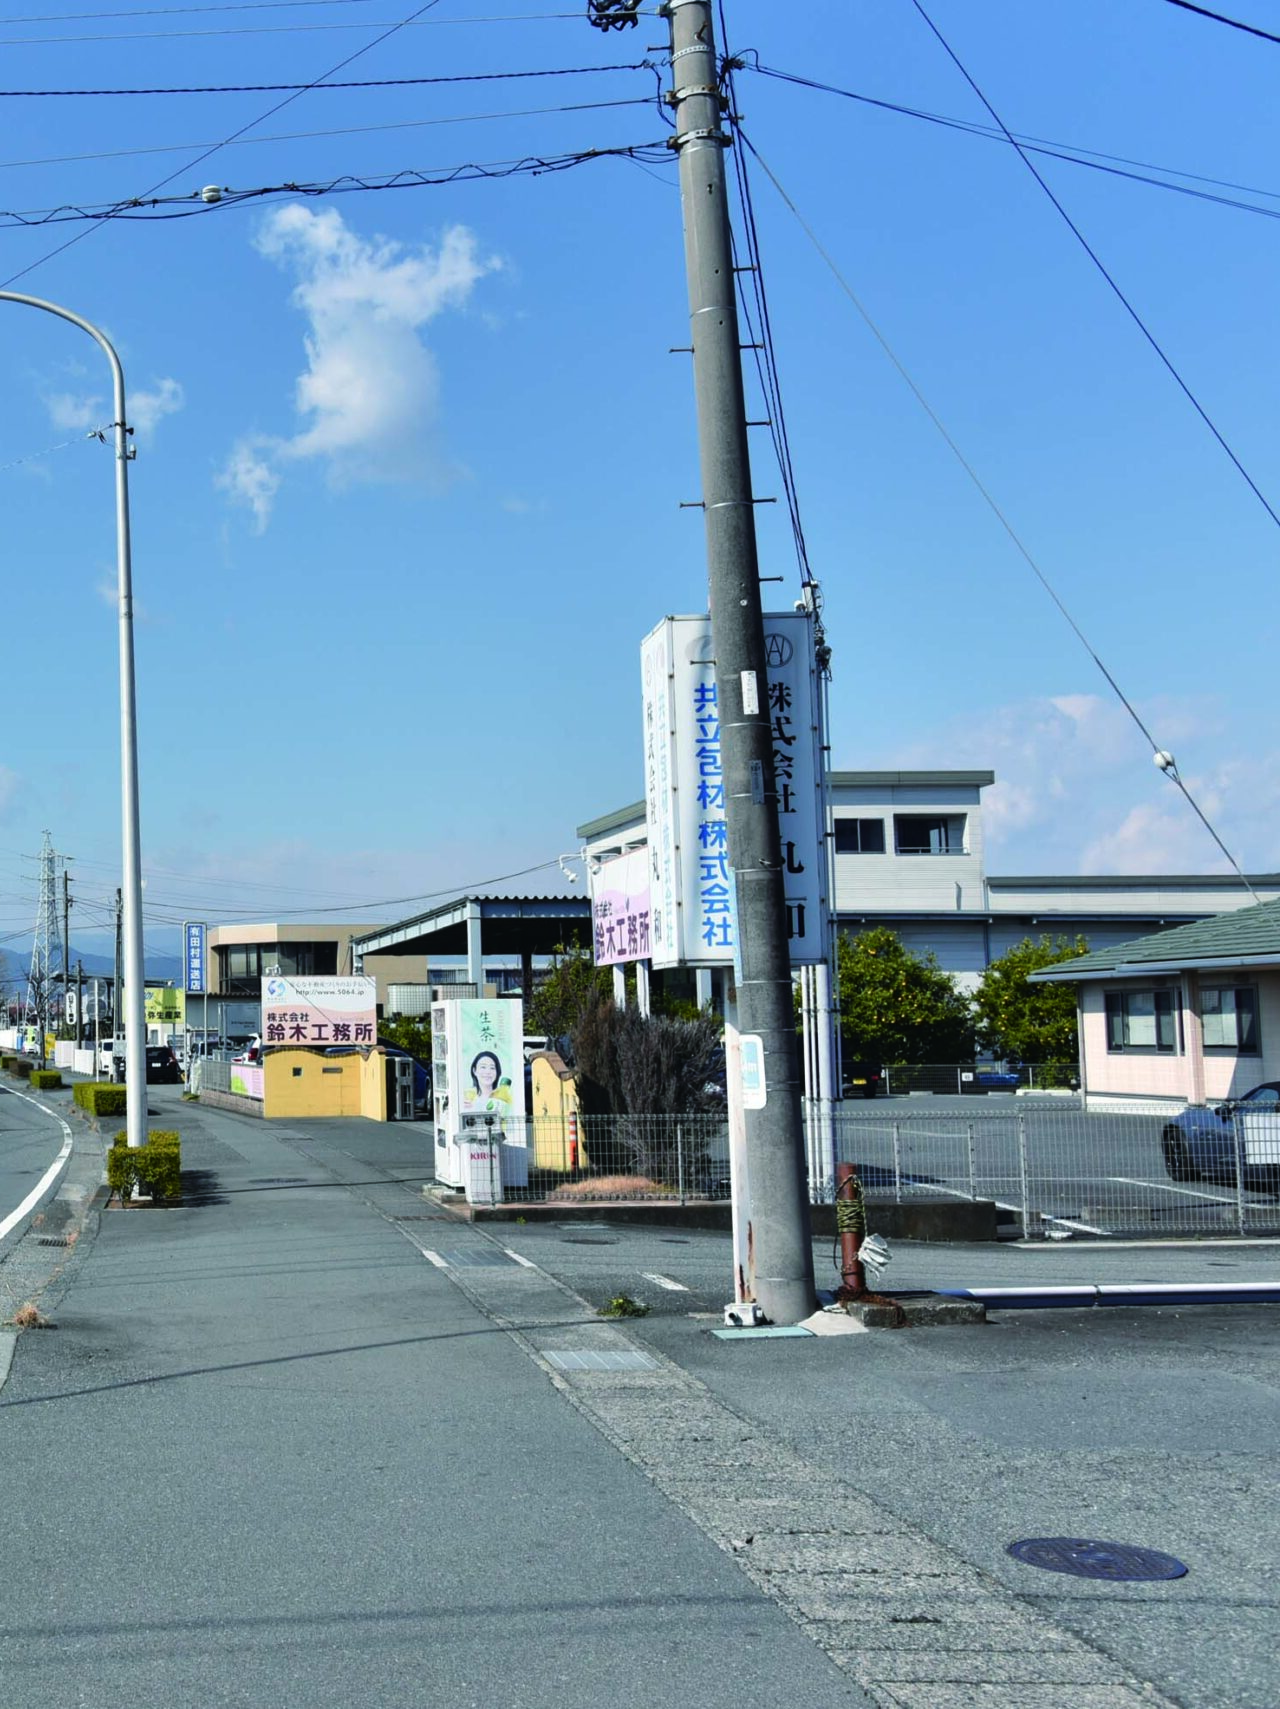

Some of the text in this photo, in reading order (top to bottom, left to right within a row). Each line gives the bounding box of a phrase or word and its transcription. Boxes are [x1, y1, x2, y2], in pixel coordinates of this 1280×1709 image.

[595, 910, 650, 961] 鈴木工務所
[267, 1013, 310, 1023] 株式会社
[480, 1010, 495, 1042] 生茶
[267, 1023, 373, 1042] 鈴木工務所
